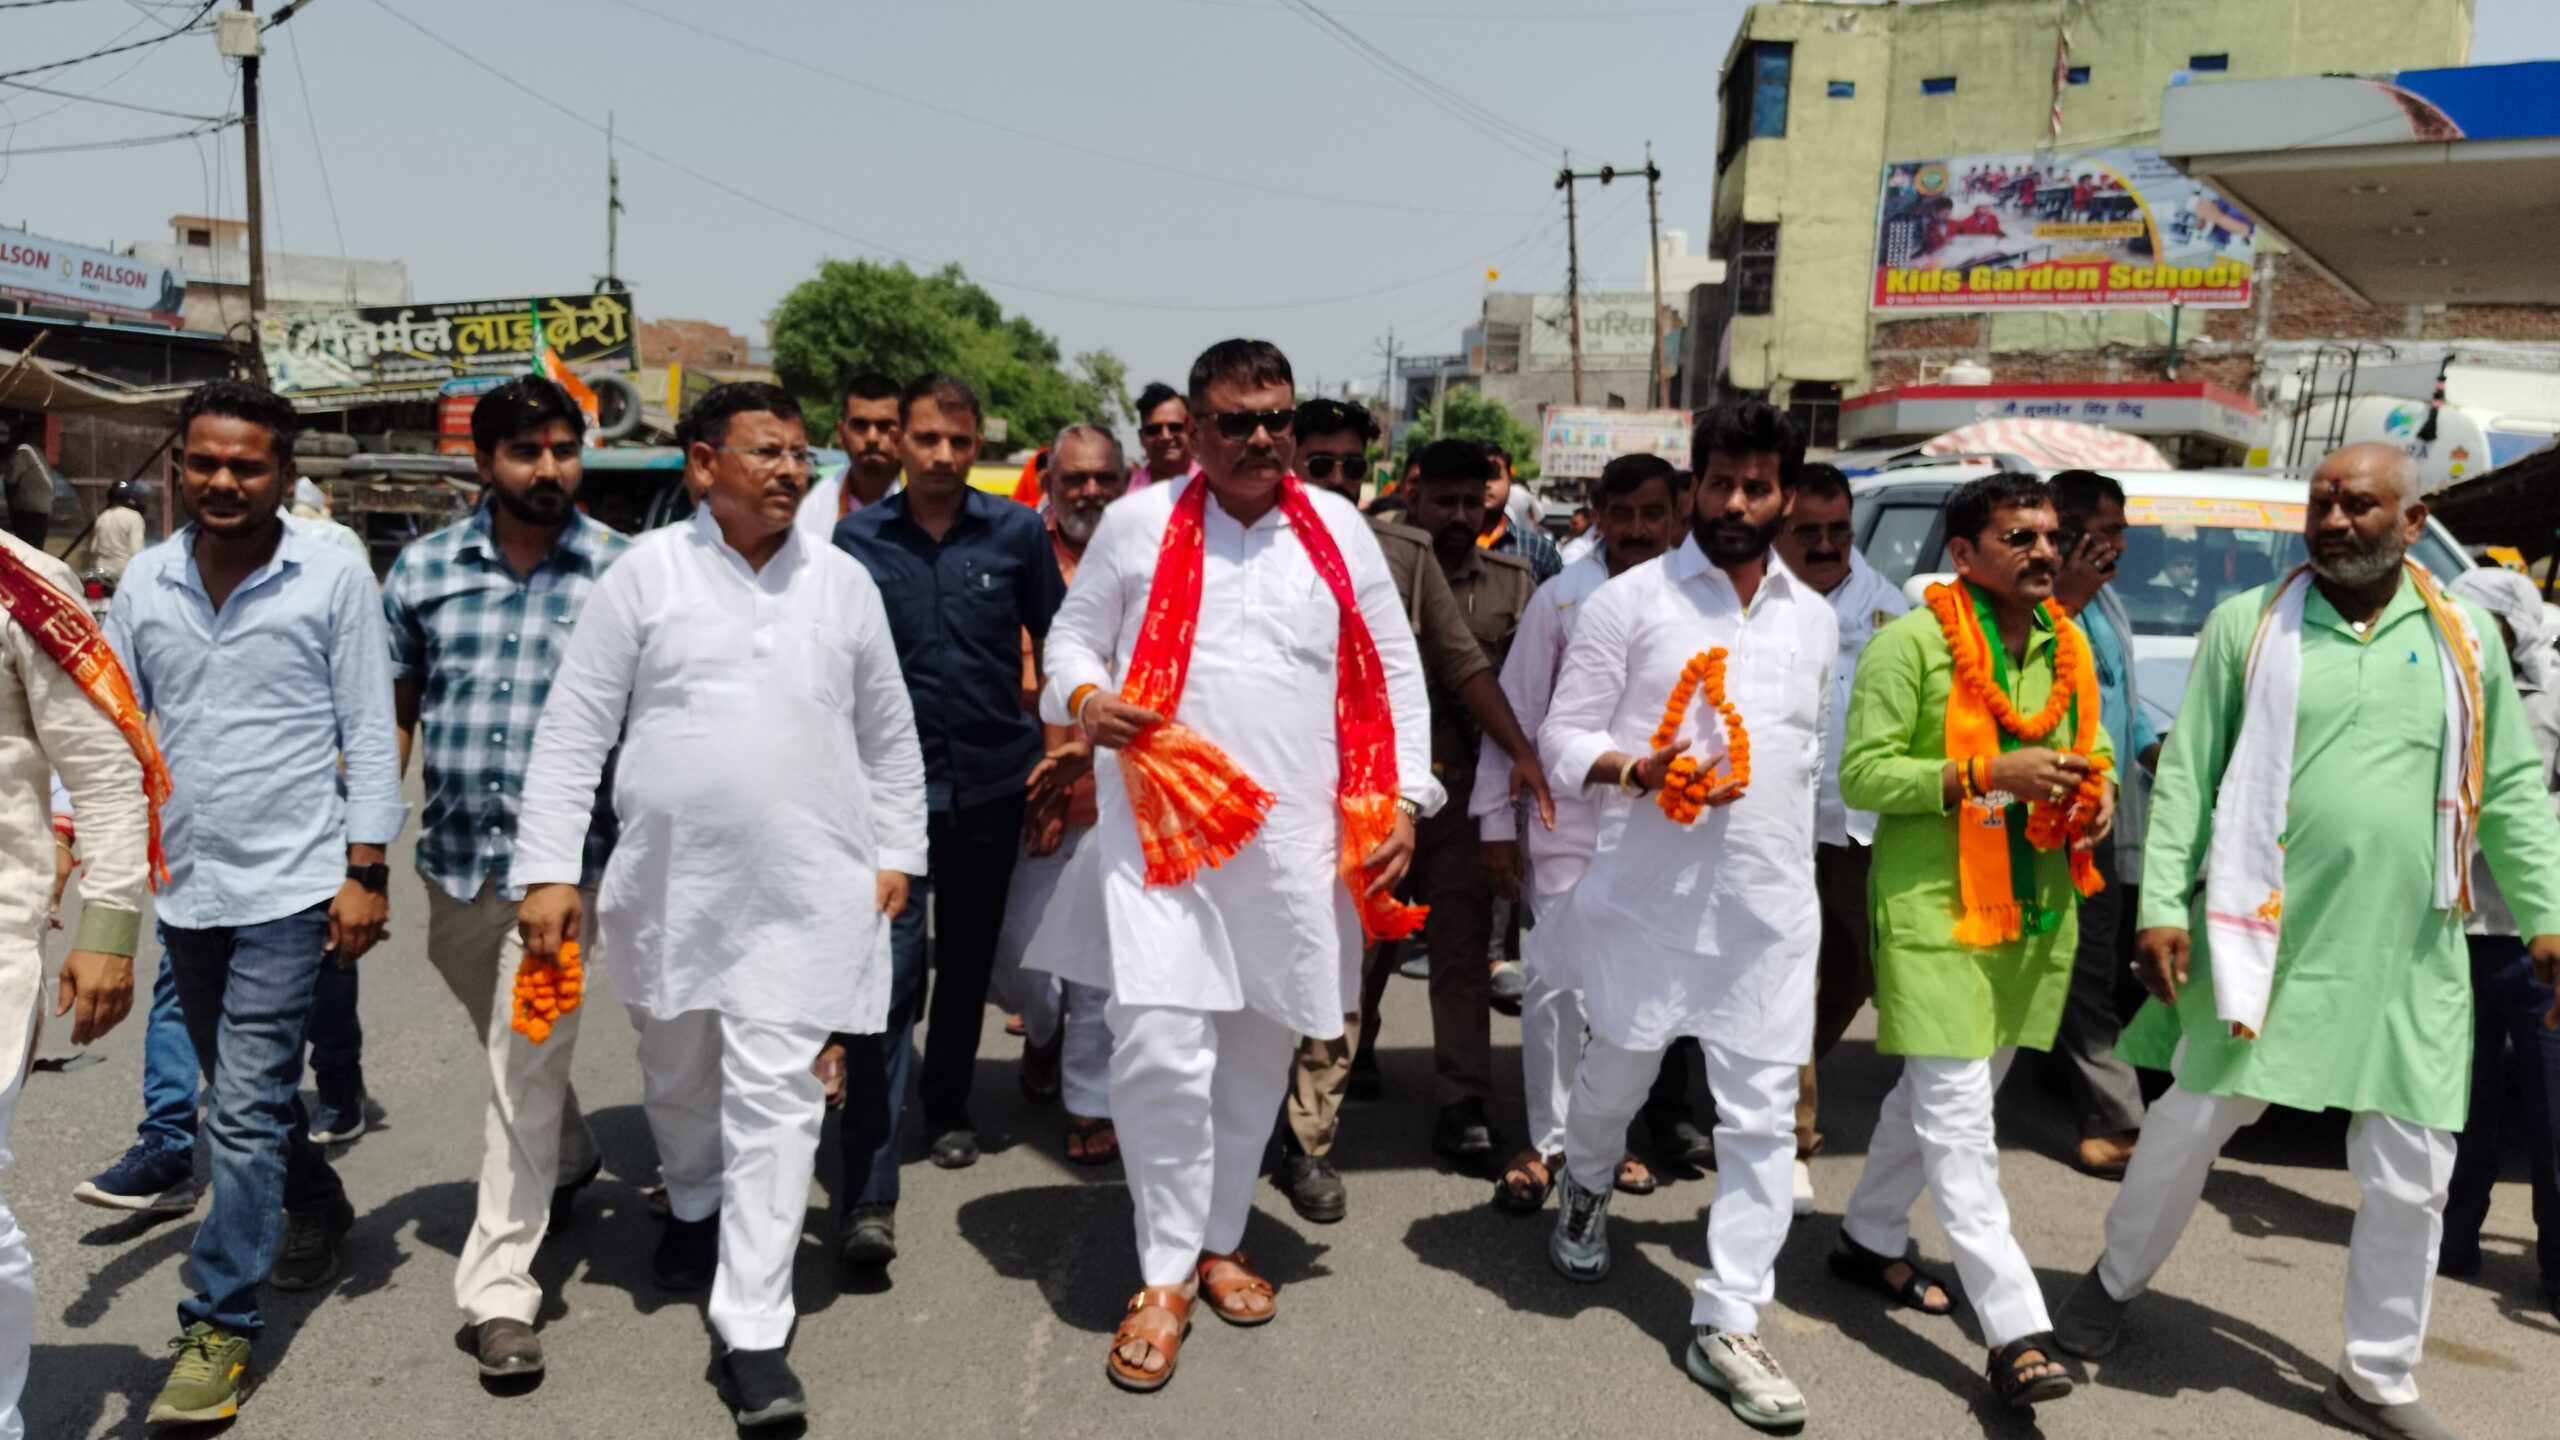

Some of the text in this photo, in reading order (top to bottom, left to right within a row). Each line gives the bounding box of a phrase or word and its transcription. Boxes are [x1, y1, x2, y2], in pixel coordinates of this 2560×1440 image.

[0, 243, 50, 270] LSON
[81, 260, 148, 289] RALSON
[1886, 261, 2241, 294] Kids Garden School
